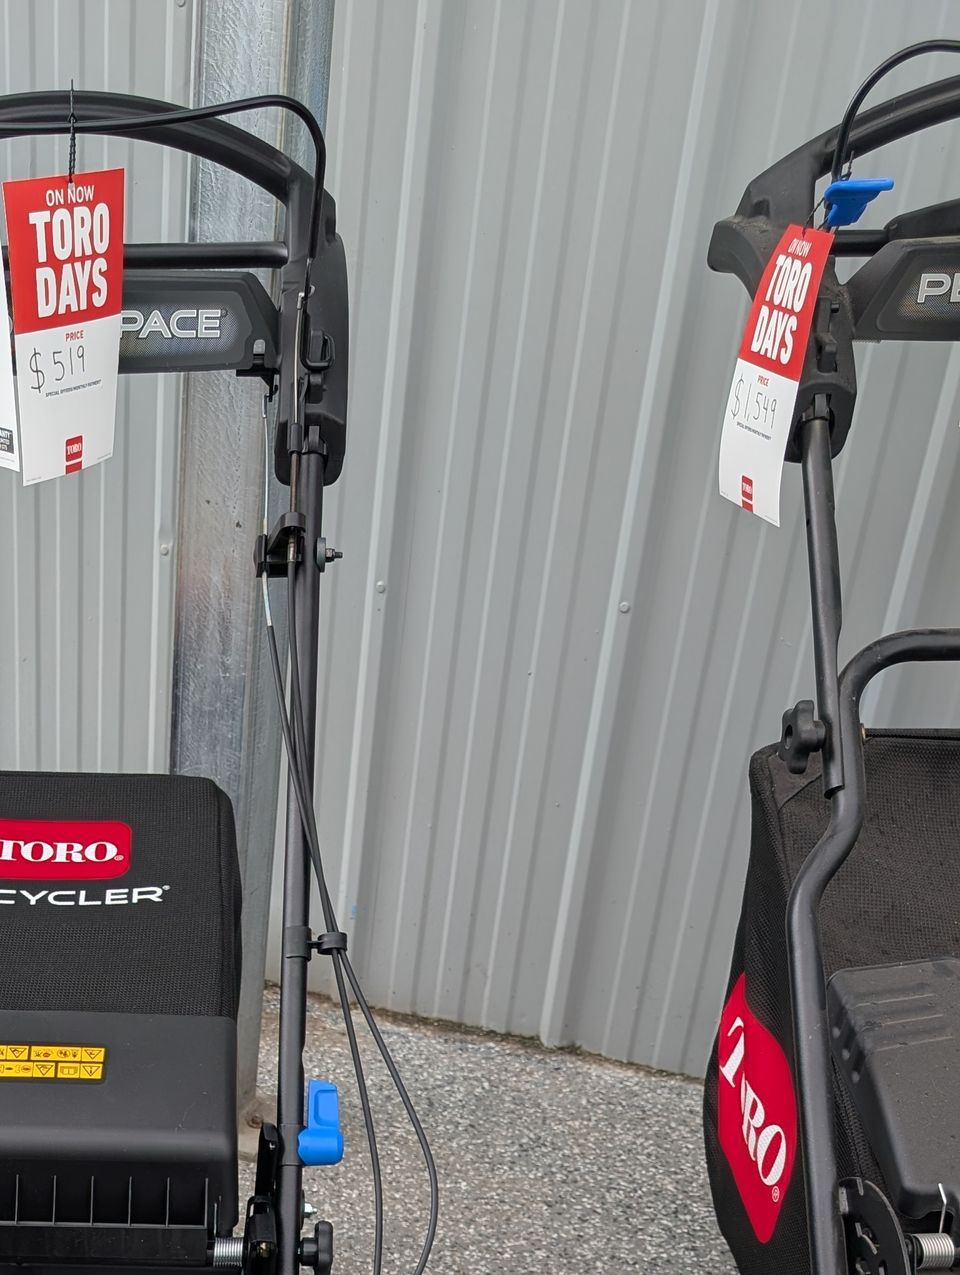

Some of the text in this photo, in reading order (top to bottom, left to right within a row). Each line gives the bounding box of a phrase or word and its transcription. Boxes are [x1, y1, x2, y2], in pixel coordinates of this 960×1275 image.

[46, 185, 94, 206] ON NOW
[28, 202, 110, 263] TORO
[788, 238, 811, 258] ON NOW
[35, 257, 108, 318] DAYS
[765, 254, 812, 313] TORO
[65, 330, 84, 342] PRICE
[750, 304, 798, 365] DAYS
[29, 345, 85, 393] $519
[757, 375, 769, 387] PRICE
[67, 442, 82, 454] TORO
